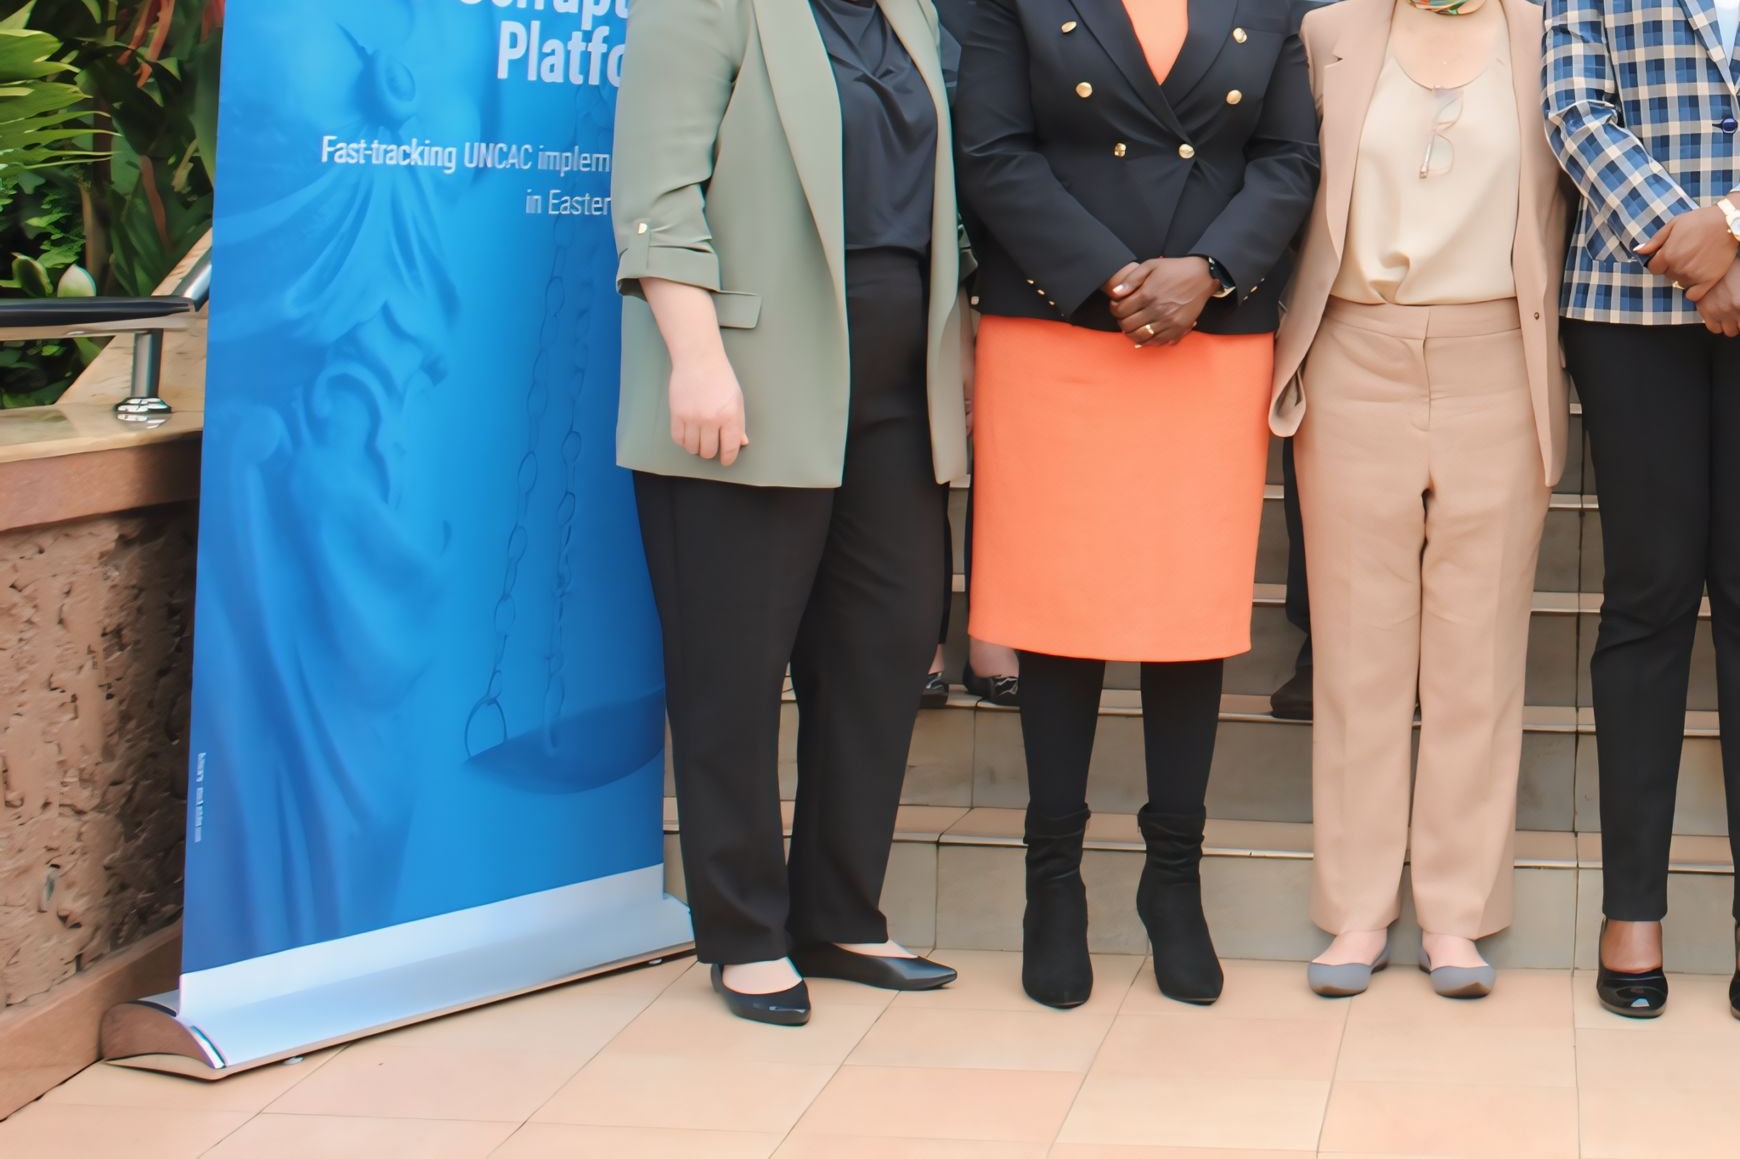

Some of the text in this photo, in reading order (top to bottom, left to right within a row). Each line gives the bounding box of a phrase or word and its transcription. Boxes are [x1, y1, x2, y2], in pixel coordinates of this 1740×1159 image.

[321, 135, 457, 174] Fast-tracking
[463, 142, 533, 170] UNCAC
[525, 188, 542, 214] in
